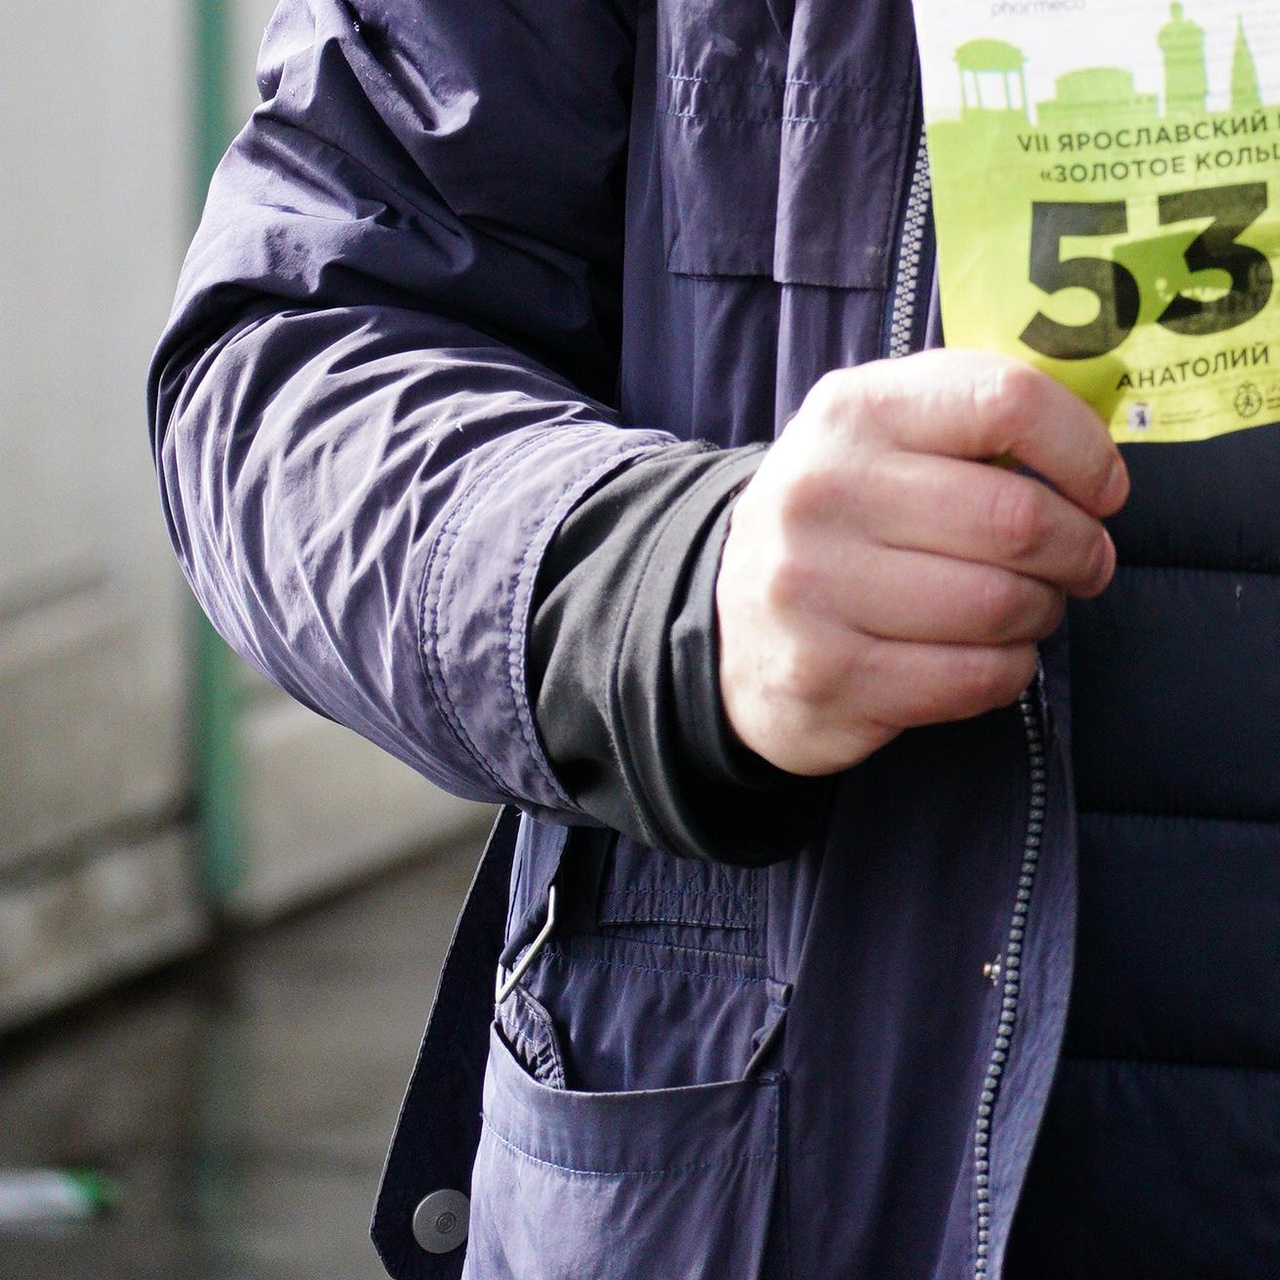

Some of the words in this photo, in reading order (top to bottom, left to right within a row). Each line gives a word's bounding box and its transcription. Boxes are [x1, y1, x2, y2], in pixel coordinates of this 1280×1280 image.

[1017, 133, 1049, 152] VII
[1057, 109, 1268, 152] ЯРОСЛАВСКИЙ
[1040, 155, 1186, 183] «ЗОЛОТОЕ
[1116, 341, 1269, 390] АНАТОЛИЙ
